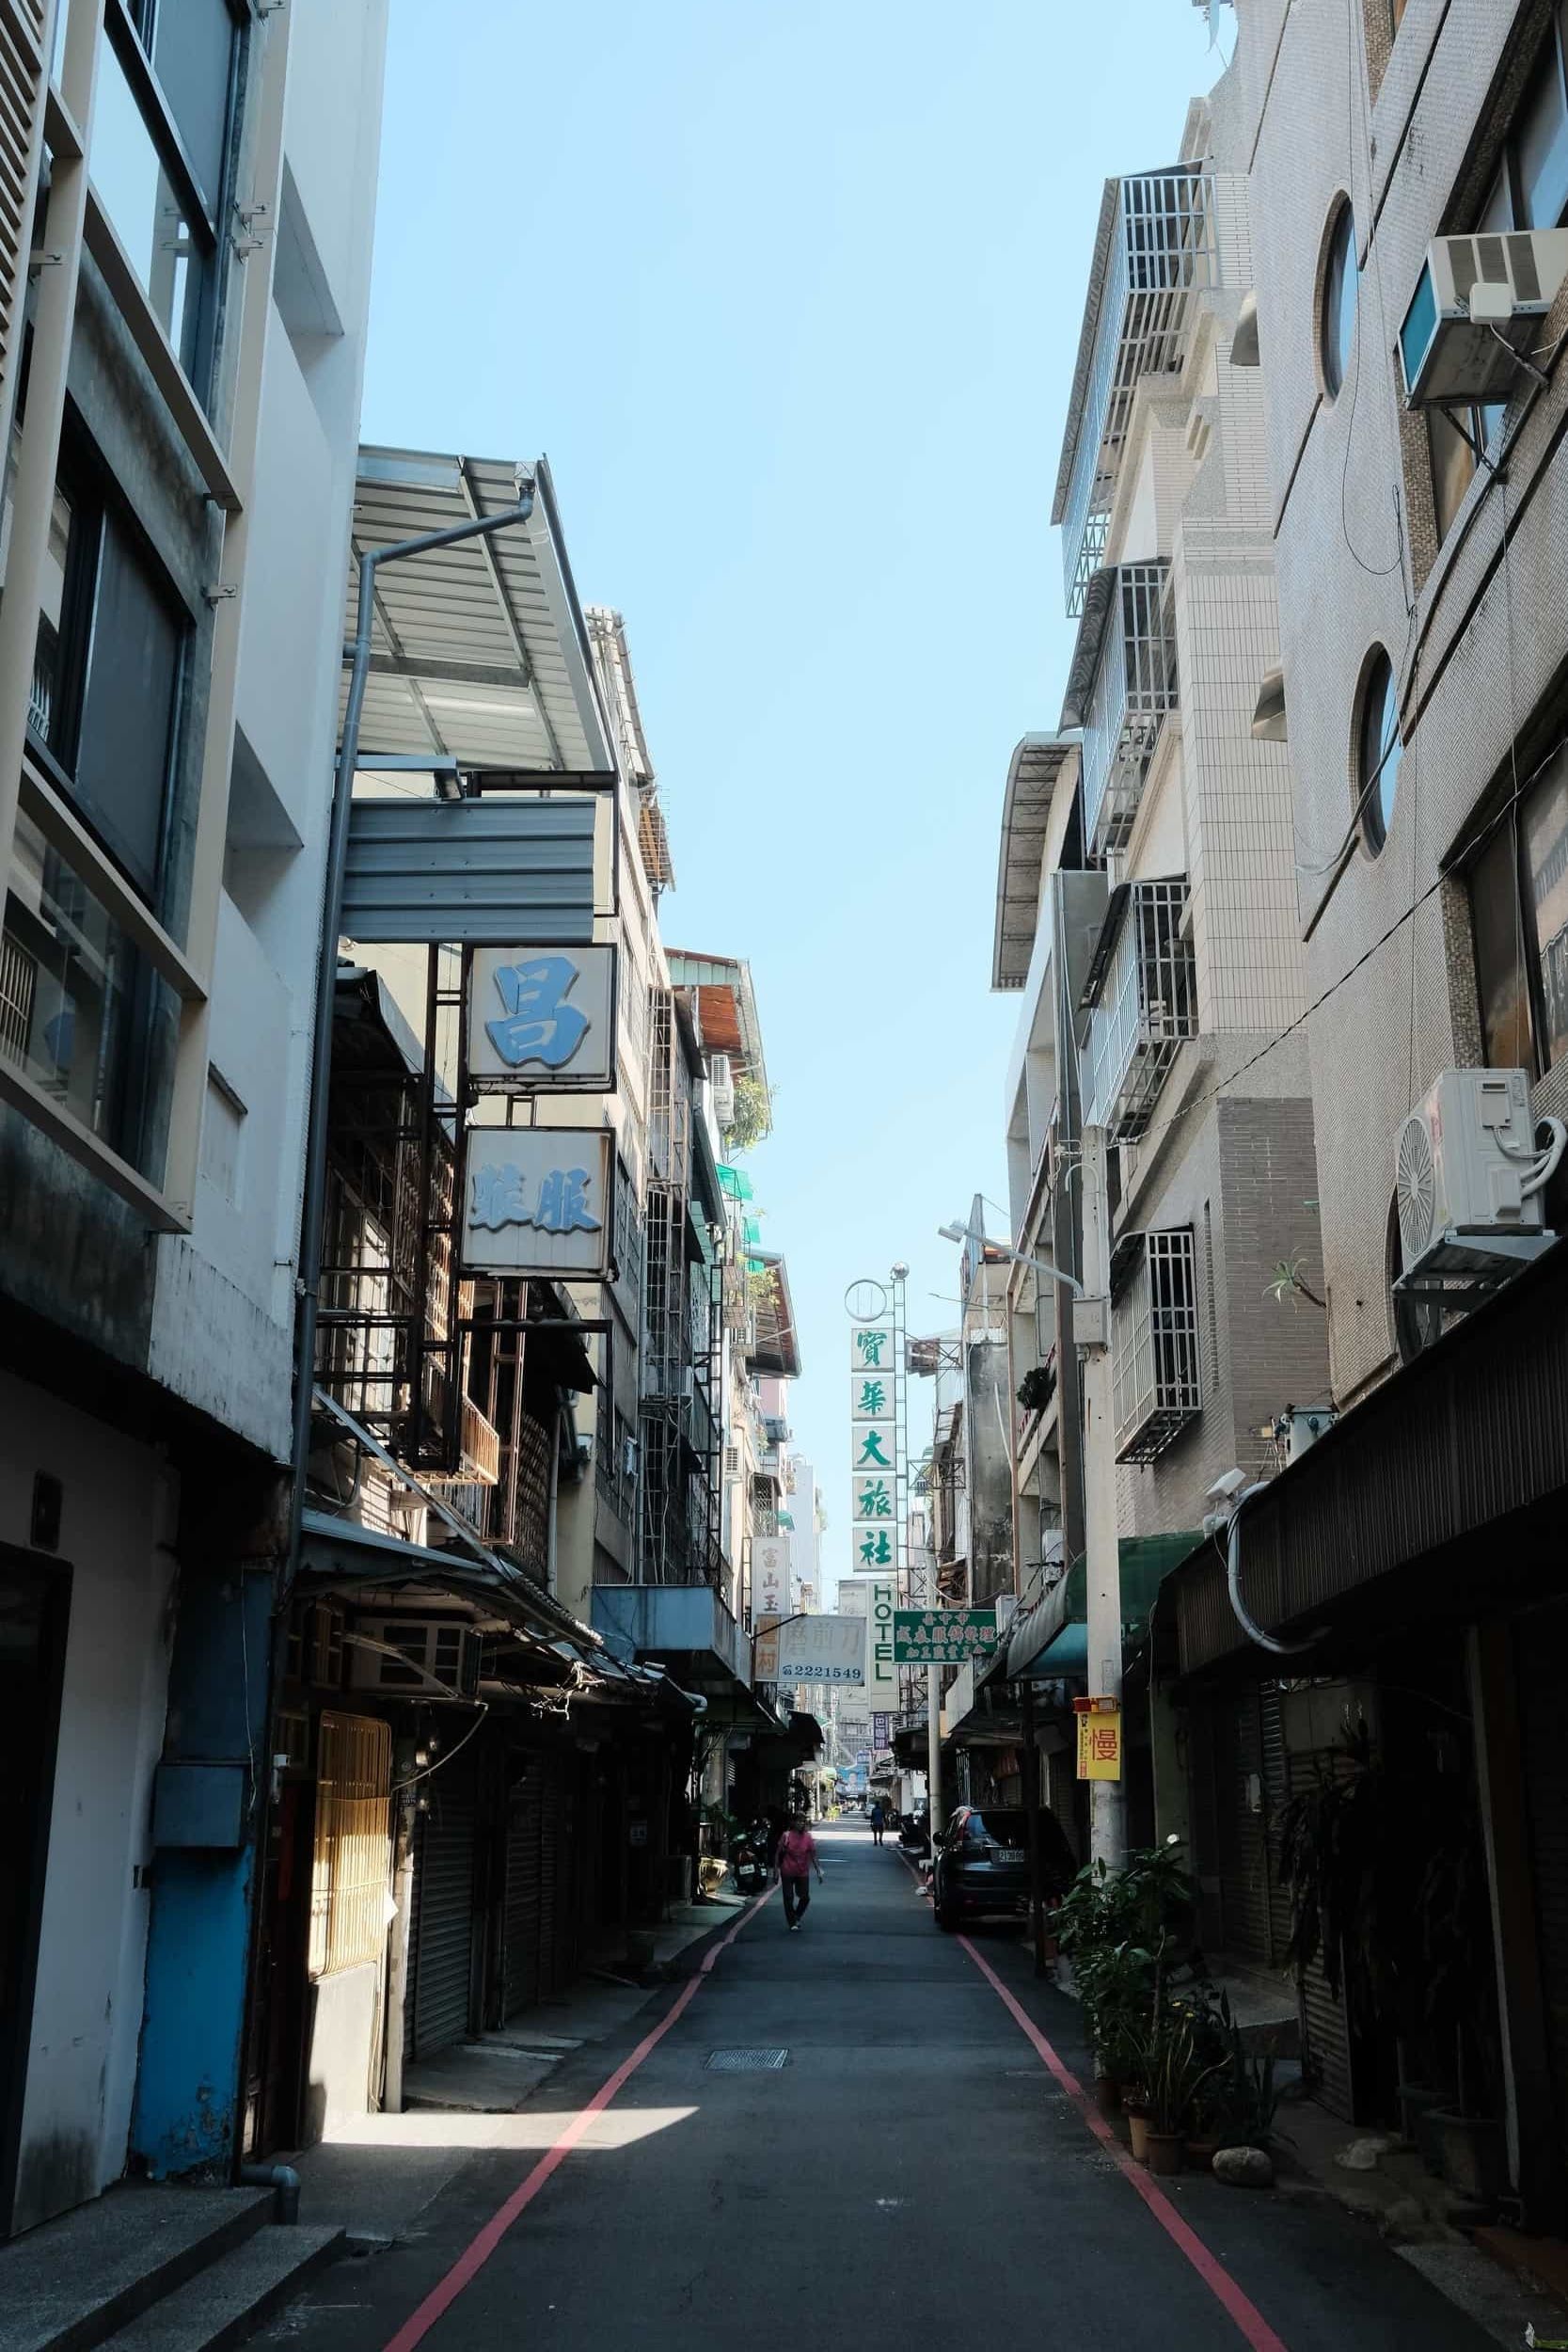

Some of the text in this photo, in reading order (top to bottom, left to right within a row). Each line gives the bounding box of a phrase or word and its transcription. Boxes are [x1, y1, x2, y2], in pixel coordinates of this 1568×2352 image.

[875, 1584, 893, 1680] HOTEL
[794, 1664, 861, 1680] 2221549
[1088, 1727, 1118, 1761] 慢
